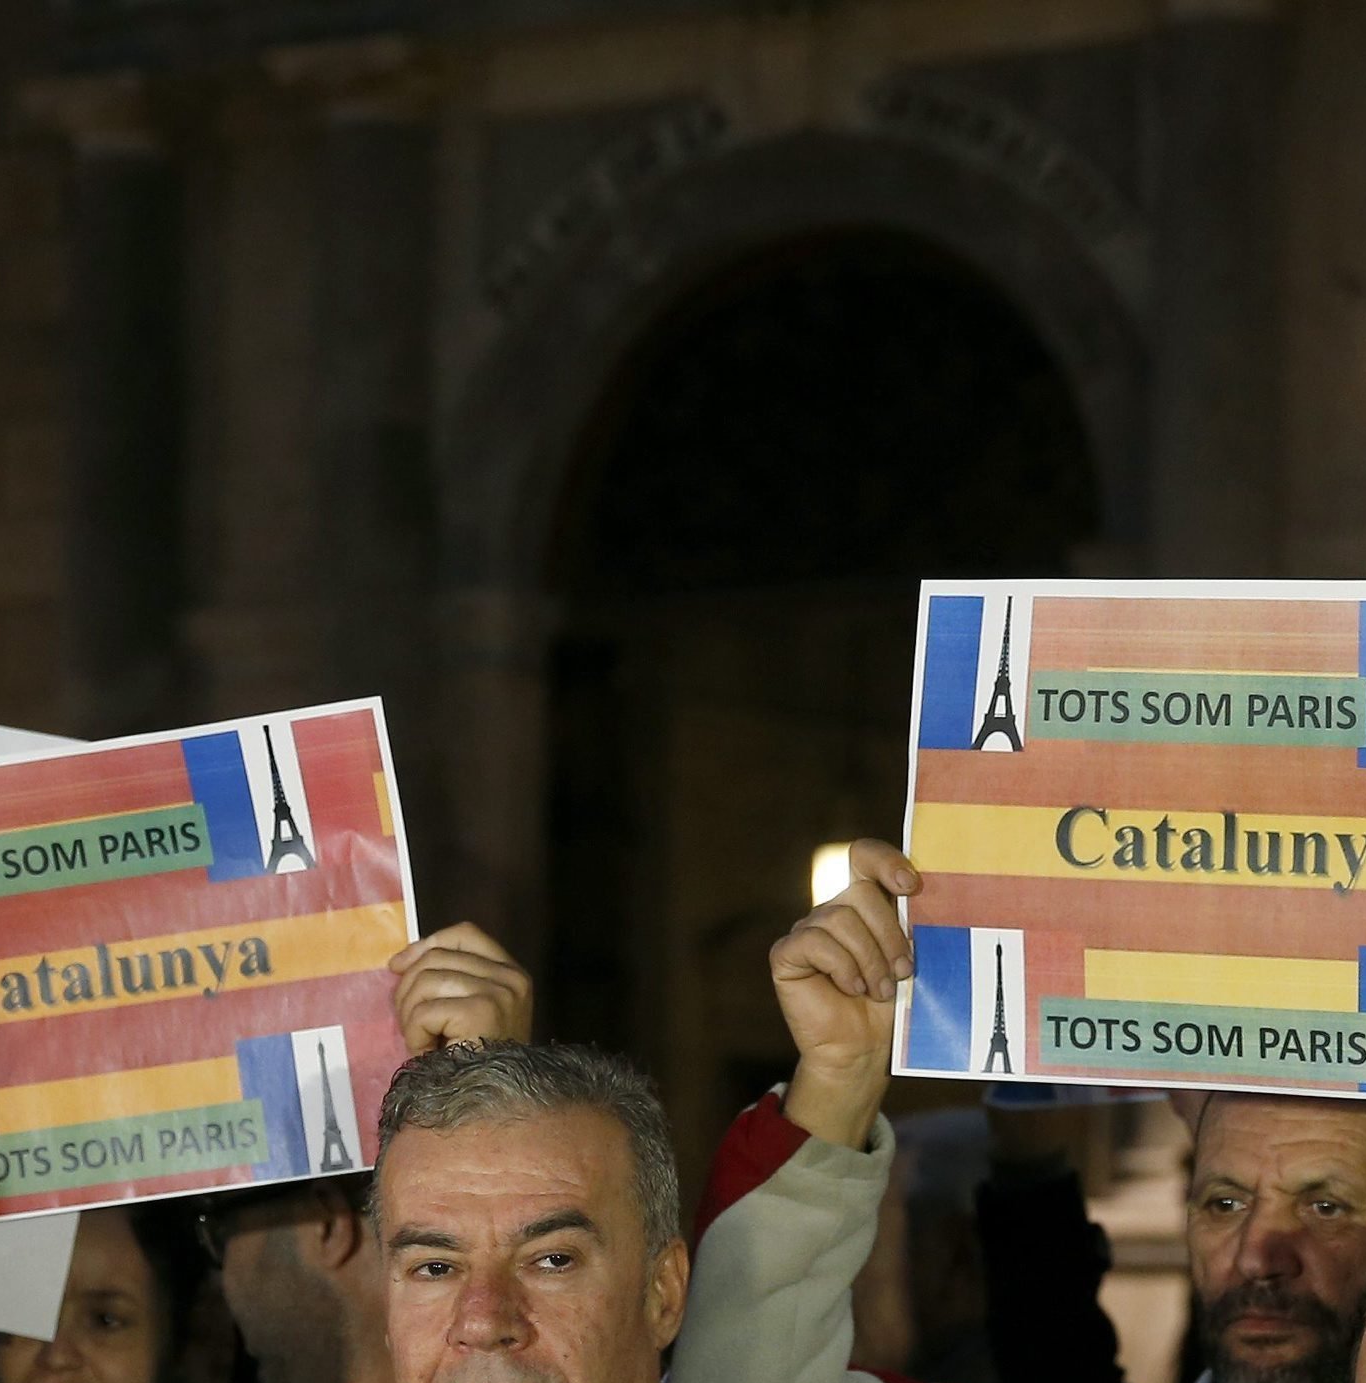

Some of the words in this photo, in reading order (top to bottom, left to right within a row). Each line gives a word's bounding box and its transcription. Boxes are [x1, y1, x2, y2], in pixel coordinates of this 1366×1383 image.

[1037, 688, 1130, 724] TOTS
[1140, 691, 1232, 727] SOM
[1247, 694, 1357, 730] PARIS
[1, 838, 88, 880] SOM
[98, 821, 201, 865] PARIS
[1046, 1015, 1142, 1053] TOTS
[1152, 1021, 1243, 1058] SOM
[60, 1132, 145, 1173] SOM
[157, 1117, 258, 1160] PARIS
